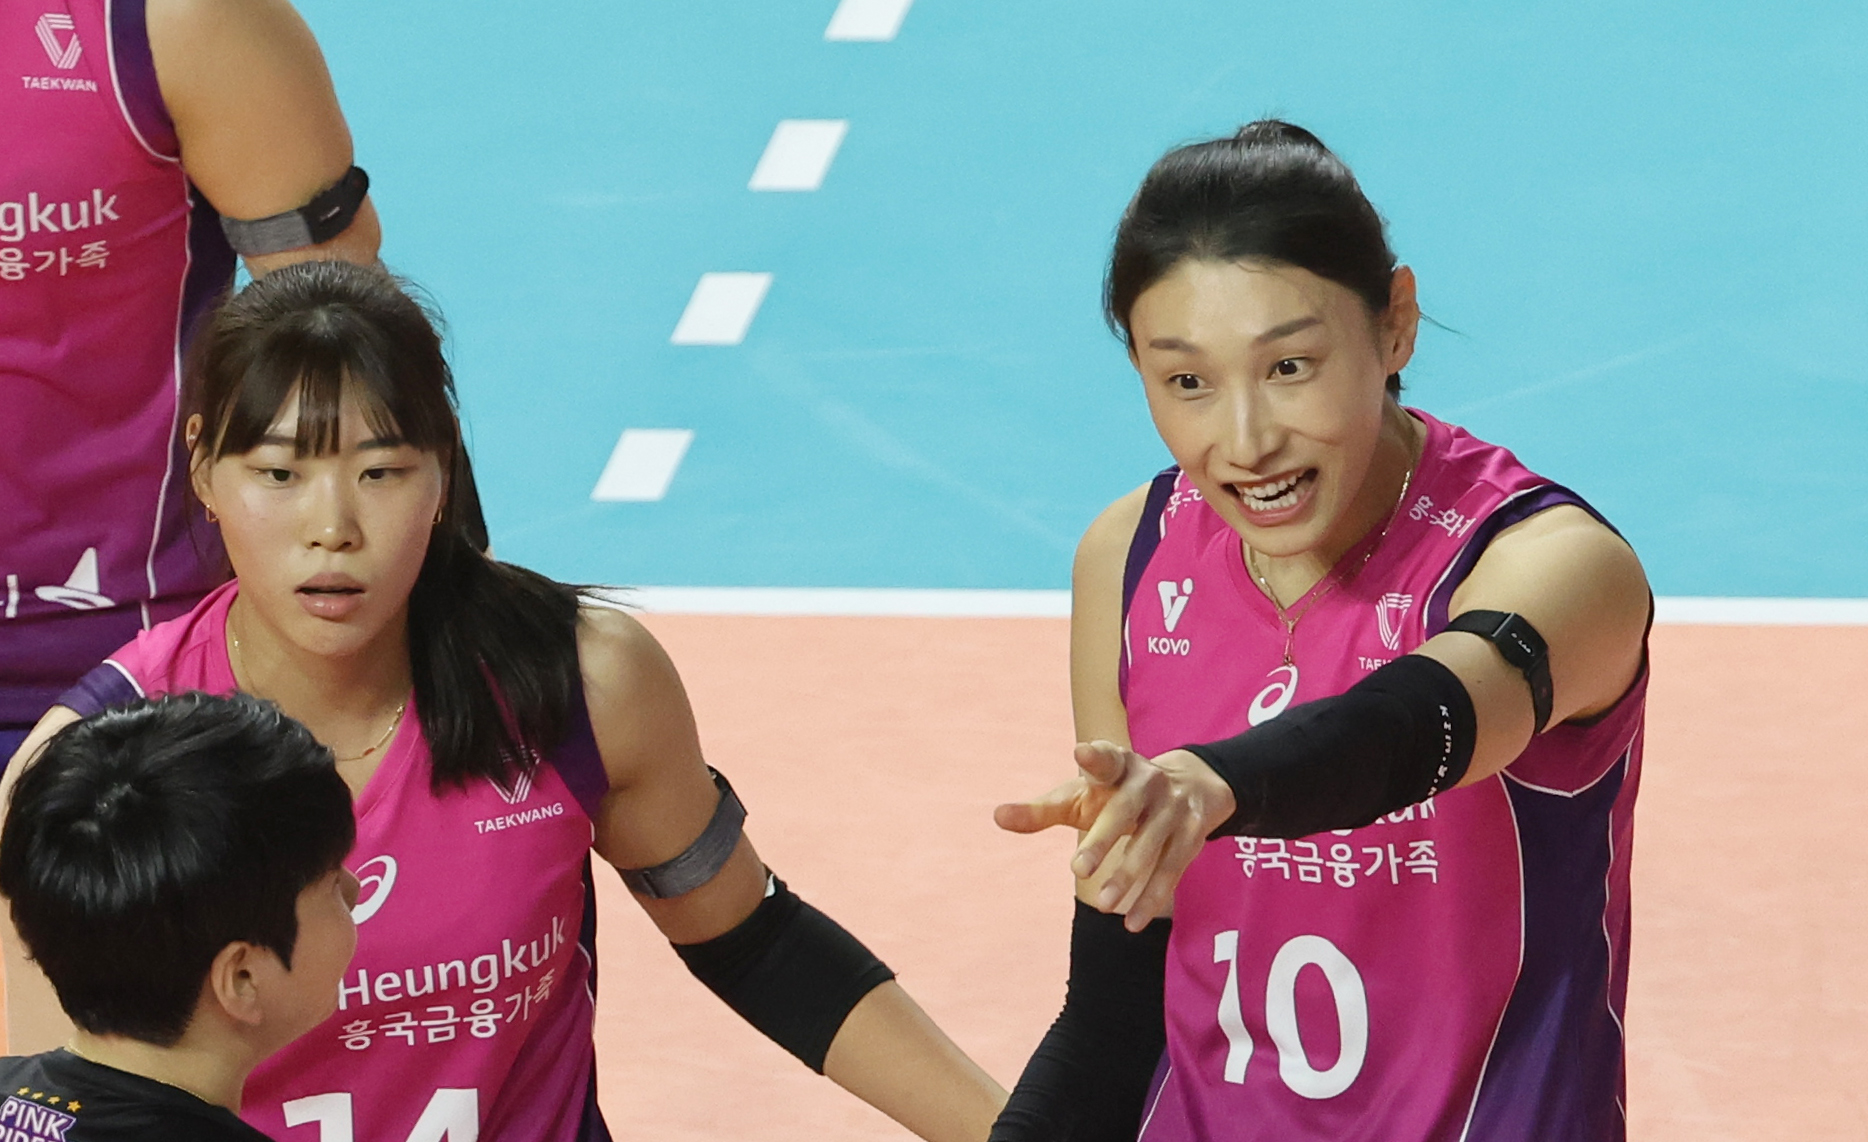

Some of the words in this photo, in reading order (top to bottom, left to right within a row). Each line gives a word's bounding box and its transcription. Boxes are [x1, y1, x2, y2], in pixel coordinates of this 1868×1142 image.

[0, 188, 121, 241] gkuk
[1147, 636, 1190, 656] KOVO
[474, 802, 564, 834] TAEKWANG
[1234, 836, 1438, 888] 흥국금융가족
[338, 915, 565, 1011] Heungkuk
[337, 968, 555, 1050] 흥국금융가족
[1213, 930, 1368, 1099] 10
[1, 1100, 69, 1140] PINK
